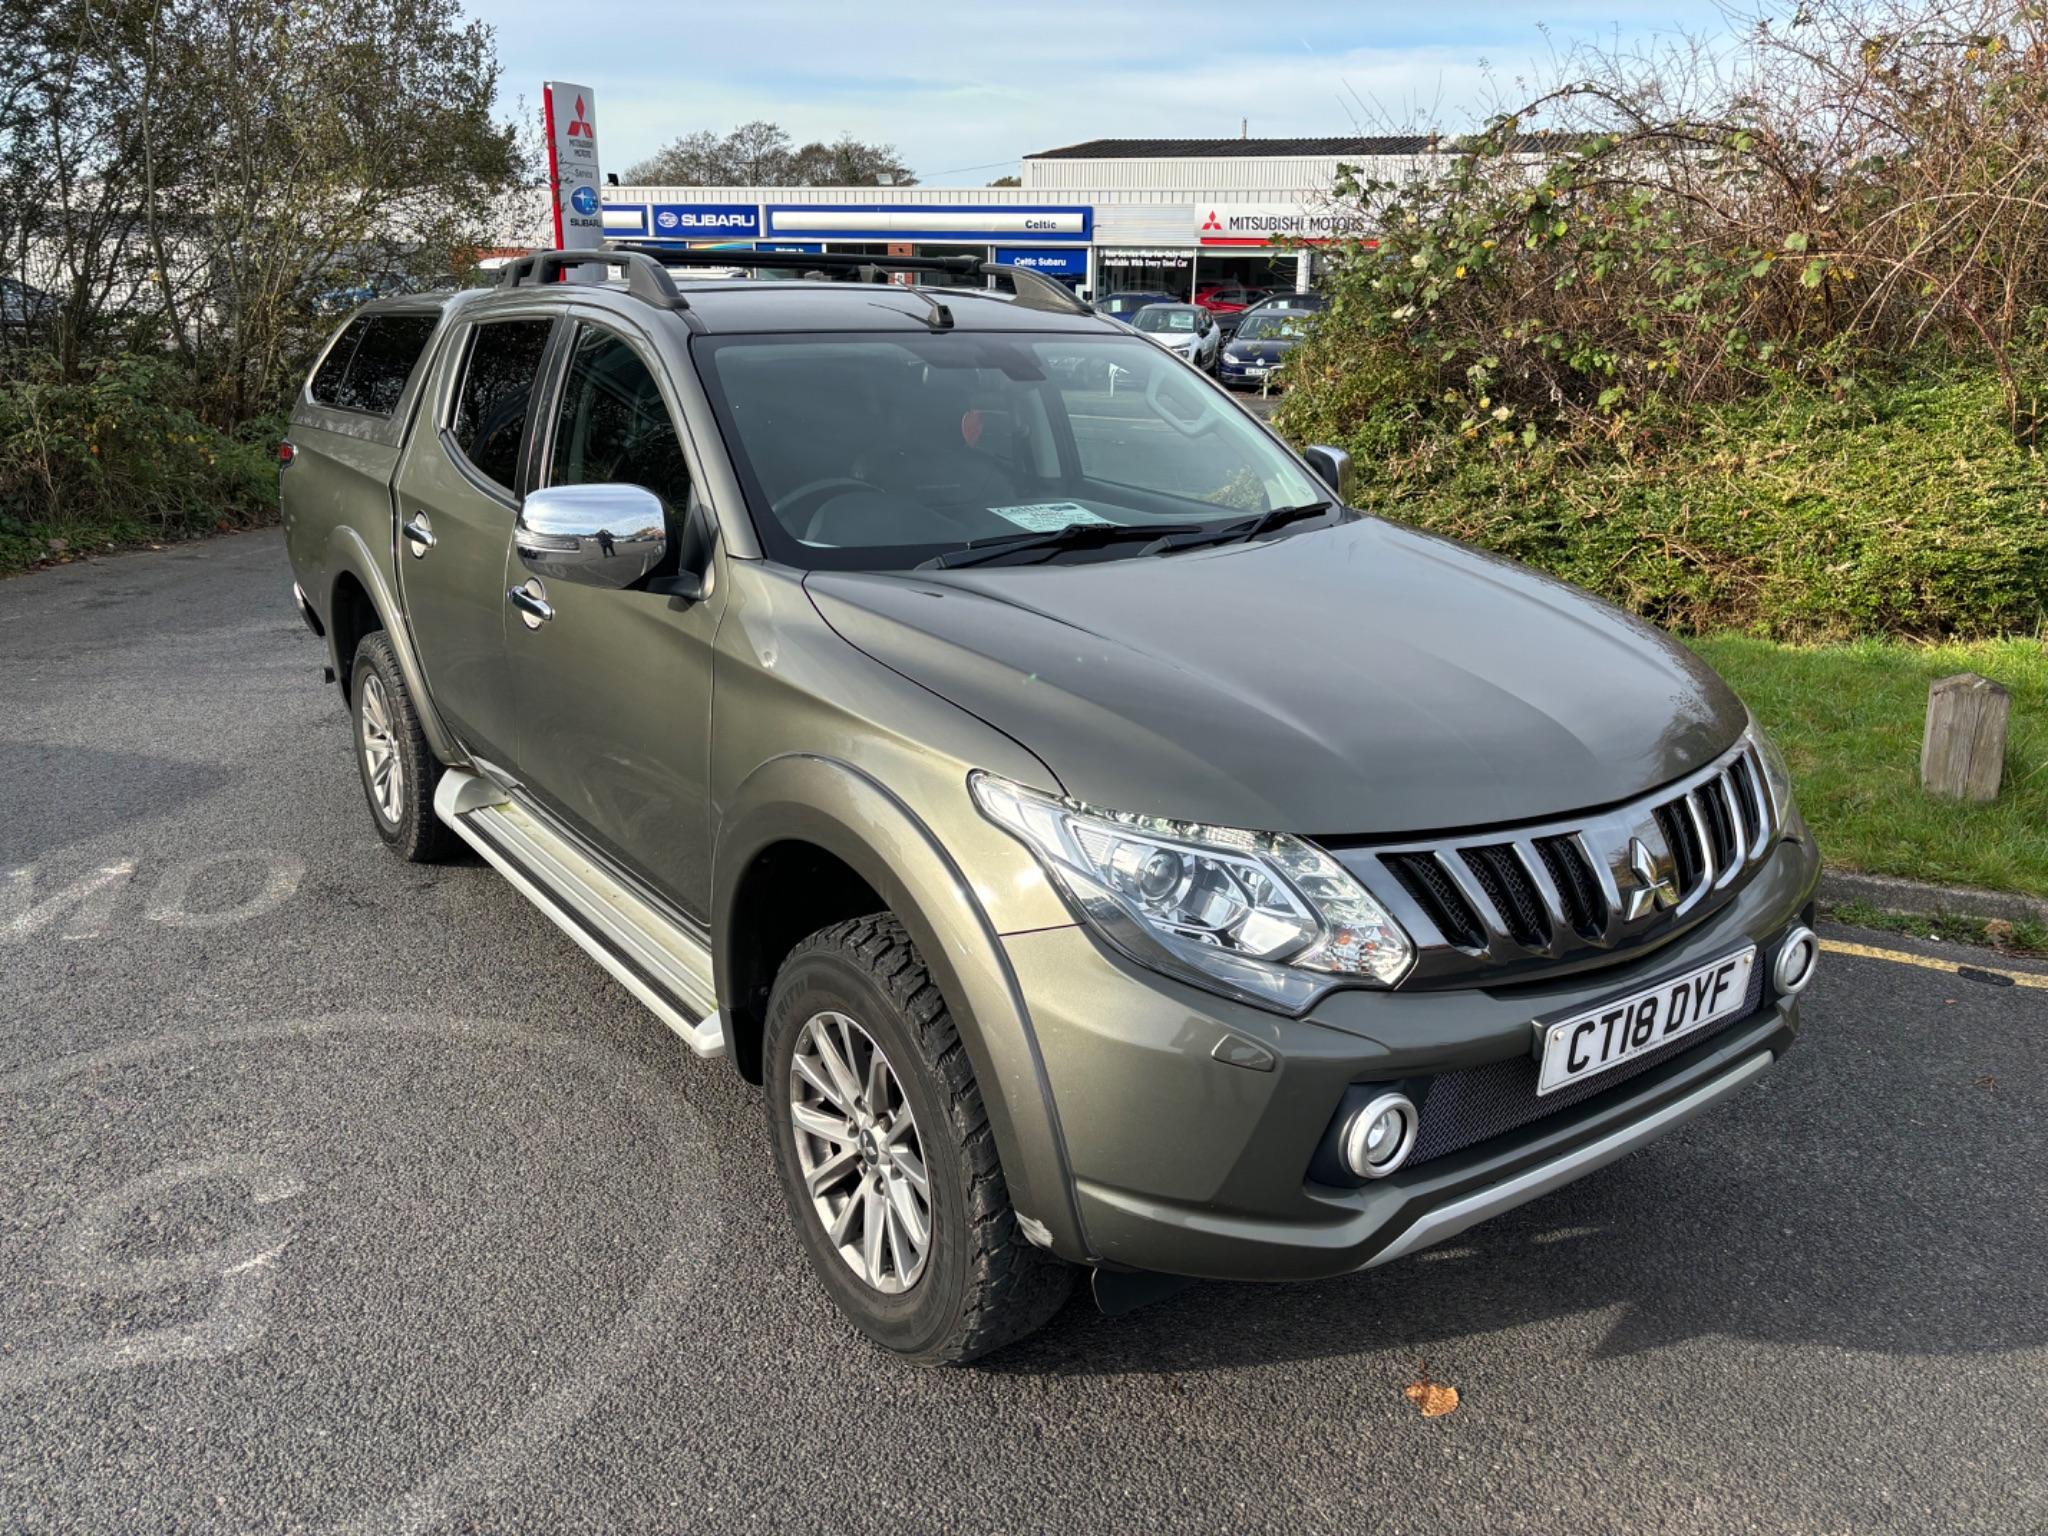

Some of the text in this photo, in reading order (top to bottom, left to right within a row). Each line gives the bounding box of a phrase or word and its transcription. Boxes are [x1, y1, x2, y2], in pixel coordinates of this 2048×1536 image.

[681, 213, 755, 227] SUBARU
[1025, 219, 1057, 229] Celtic
[1229, 216, 1365, 232] MITSUBISHI MOTORS
[1014, 257, 1067, 267] Celtic Subaru
[1104, 258, 1129, 267] Available
[1131, 258, 1144, 267] With
[1145, 258, 1161, 269] Every
[1177, 259, 1188, 268] Car
[1566, 960, 1737, 1074] CT18 DYF
